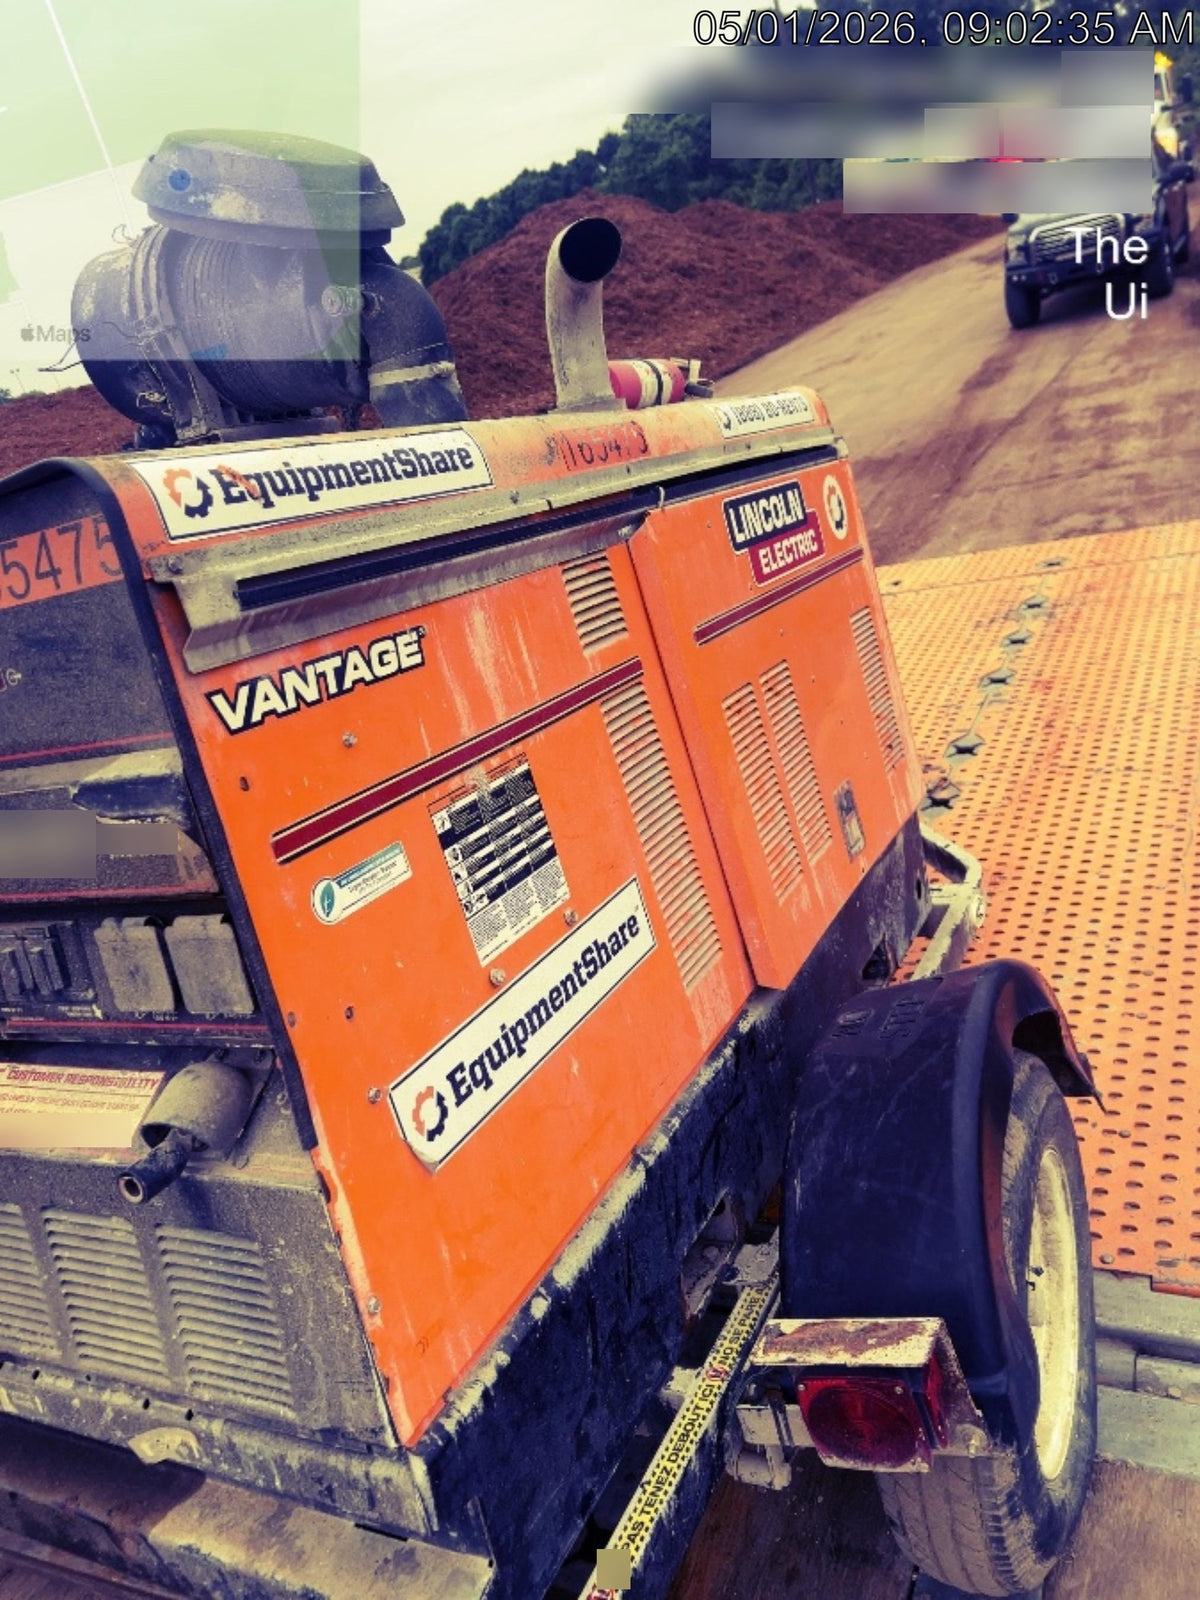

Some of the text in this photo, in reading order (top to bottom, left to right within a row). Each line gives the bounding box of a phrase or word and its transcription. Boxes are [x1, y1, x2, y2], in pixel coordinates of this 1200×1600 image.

[208, 446, 474, 510] EquipmentShare
[728, 487, 805, 543] LINCOLN
[0, 515, 122, 600] 5475
[759, 529, 819, 575] ELECTRIC
[206, 628, 424, 734] VANTAGE
[445, 914, 640, 1108] EquipmentShare
[6, 1069, 65, 1084] CUSTOMER
[718, 1346, 734, 1367] NO
[729, 1324, 743, 1346] SE
[737, 1297, 760, 1329] PARE
[640, 1464, 672, 1516] TENEZ
[668, 1402, 706, 1463] DEBOUT
[700, 1383, 716, 1403] ICI
